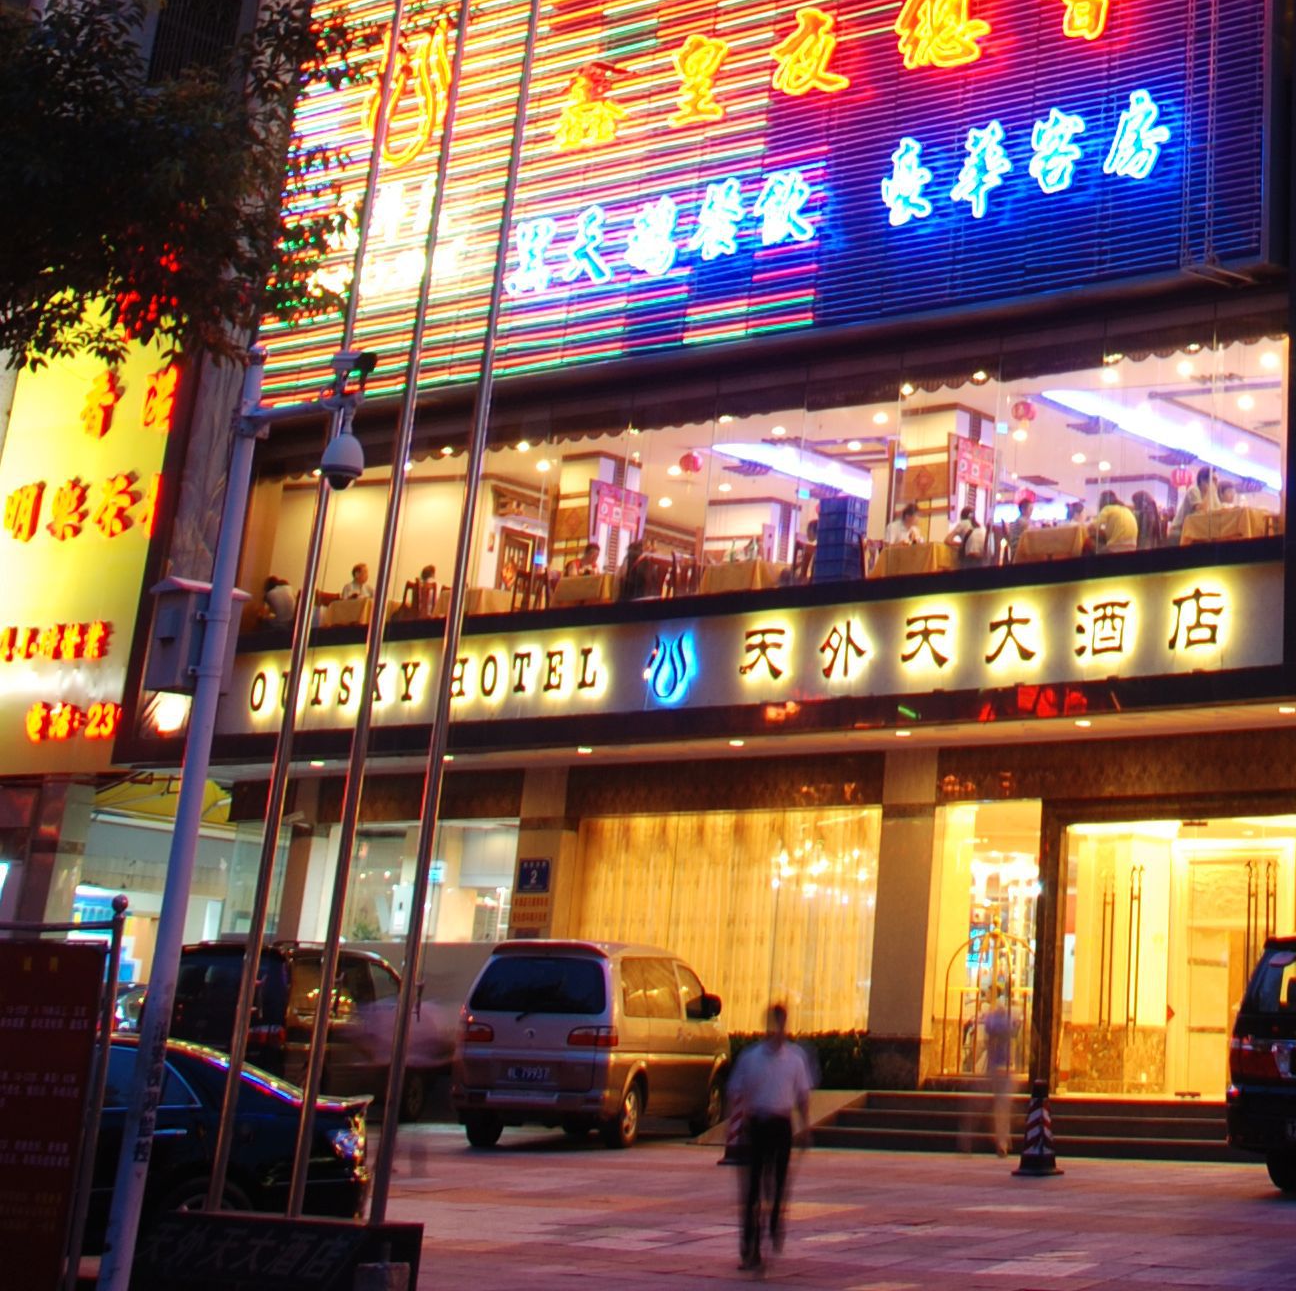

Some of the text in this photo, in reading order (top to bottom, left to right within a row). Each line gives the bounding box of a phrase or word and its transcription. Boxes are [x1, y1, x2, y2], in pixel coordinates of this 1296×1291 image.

[739, 587, 1226, 681] 天外天大酒店
[449, 647, 601, 699] HOTEL
